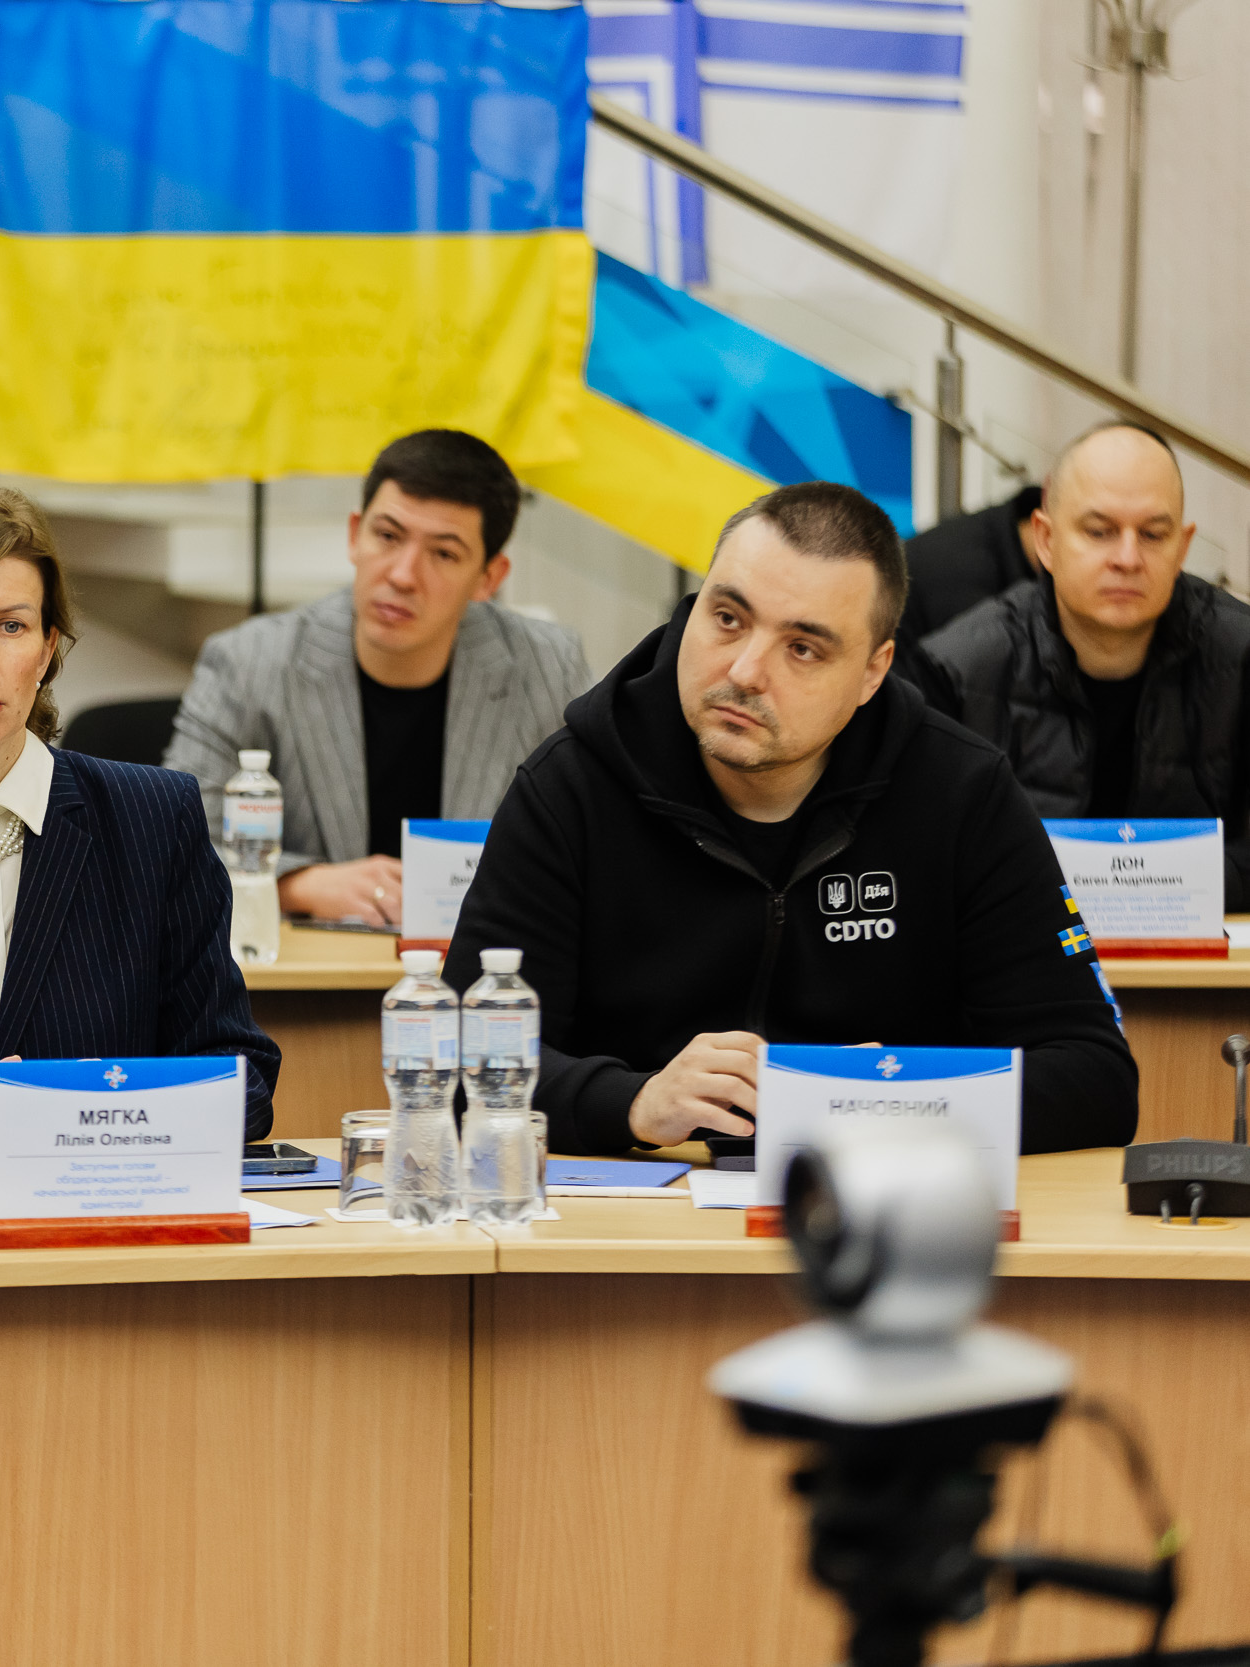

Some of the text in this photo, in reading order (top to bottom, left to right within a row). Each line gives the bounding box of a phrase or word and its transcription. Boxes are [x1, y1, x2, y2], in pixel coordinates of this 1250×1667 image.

[1110, 856, 1144, 872] ДОН
[864, 883, 891, 900] Дія
[824, 917, 896, 943] CDTO
[829, 1096, 950, 1117] НАЧОВНИЙ
[79, 1109, 149, 1126] МЯГКА
[54, 1132, 172, 1147] Лілія Олегівна
[1147, 1153, 1246, 1175] PHILIPS
